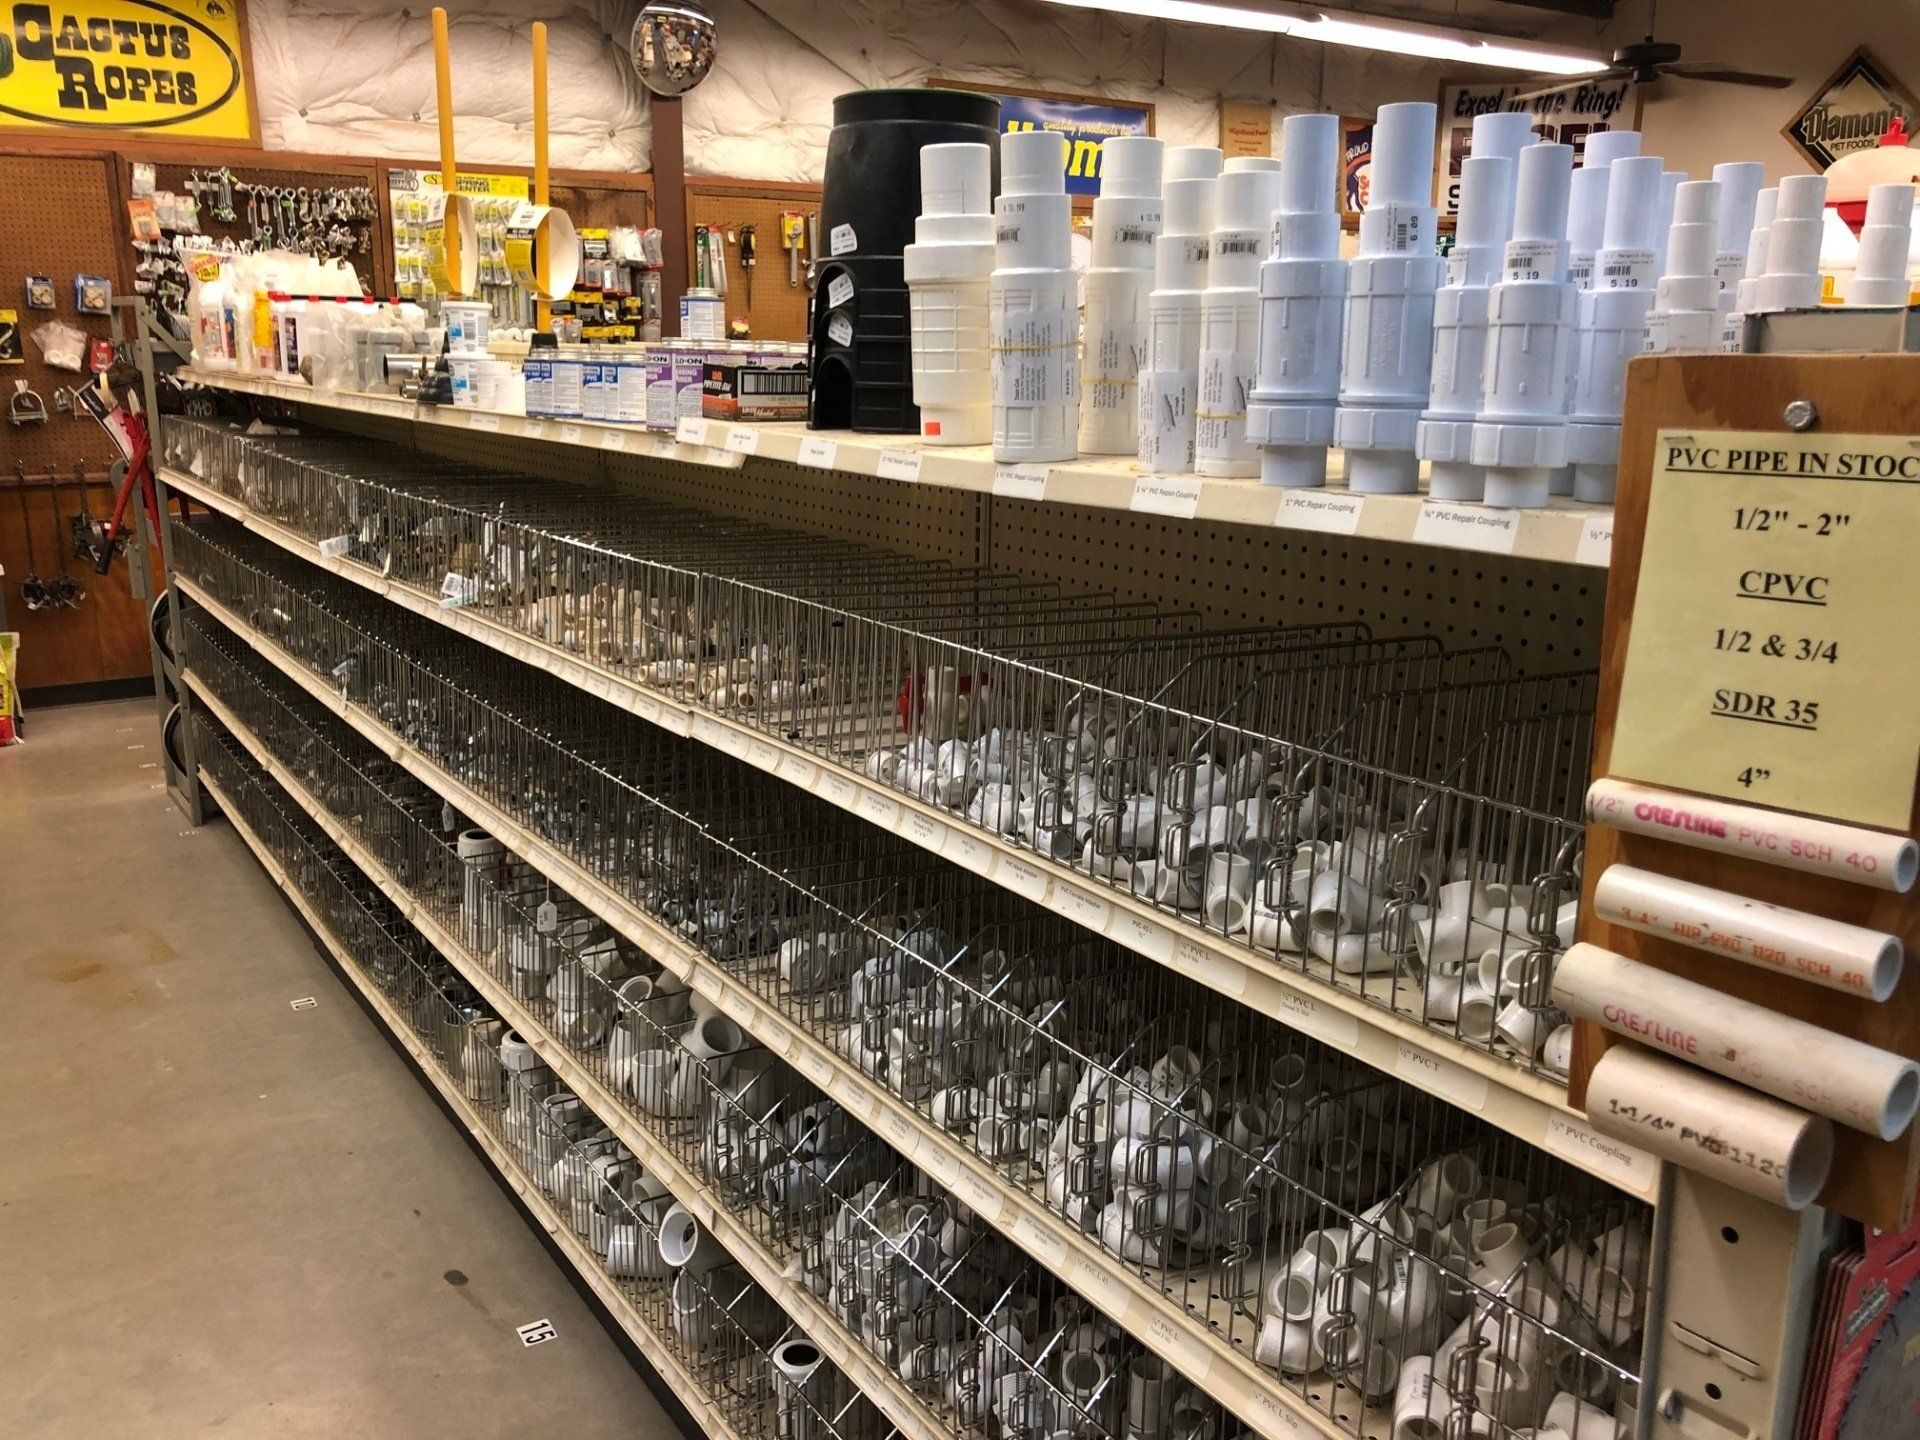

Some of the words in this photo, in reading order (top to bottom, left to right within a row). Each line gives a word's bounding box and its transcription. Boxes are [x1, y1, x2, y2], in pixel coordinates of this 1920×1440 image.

[12, 3, 191, 61] CACTUS
[54, 55, 198, 111] ROPES
[1454, 88, 1504, 116] Excel
[1572, 82, 1628, 120] Ring!
[1042, 118, 1076, 136] quality
[1078, 122, 1119, 136] products
[1830, 142, 1845, 151] PET
[1847, 139, 1875, 150] FOODS
[1513, 271, 1539, 280] 5.19
[1611, 278, 1638, 288] 5.19
[1667, 447, 1720, 469] PVC
[1726, 450, 1788, 472] PIPE
[1798, 452, 1829, 474] IN
[1159, 488, 1175, 497] Repair
[1175, 490, 1198, 501] Coupling
[1294, 499, 1306, 508] PVC
[1306, 500, 1327, 510] Repair
[1327, 502, 1356, 514] Coupling
[1436, 511, 1450, 521] PVC
[1452, 513, 1476, 524] Repair
[1477, 516, 1510, 529] Coupling
[1816, 512, 1851, 536] 2"
[1739, 569, 1829, 601] CPVC
[1714, 627, 1752, 654] 1/2
[1761, 633, 1786, 657] &
[1795, 638, 1839, 665] 3/4
[1712, 688, 1777, 719] SDR
[1784, 698, 1820, 725] 35
[1633, 803, 1727, 839] CRESLINE
[1738, 827, 1779, 851] PVC
[1789, 840, 1833, 863] SCH
[1845, 852, 1877, 874] 40
[1190, 944, 1205, 958] PVC
[1709, 931, 1741, 952] PVC
[1796, 957, 1831, 977] SCH
[1841, 972, 1866, 988] 40
[1293, 995, 1308, 1009] PVC
[1602, 1004, 1697, 1056] CRESLINE
[1412, 1052, 1432, 1070] PVC
[1432, 1062, 1440, 1072] T
[1608, 1099, 1675, 1131] 1-1/4"
[1565, 1126, 1587, 1144] PVC
[1588, 1136, 1632, 1167] Coupling
[521, 1321, 555, 1343] 15
[1160, 1322, 1174, 1337] PVC
[1262, 1396, 1278, 1413] PVC
